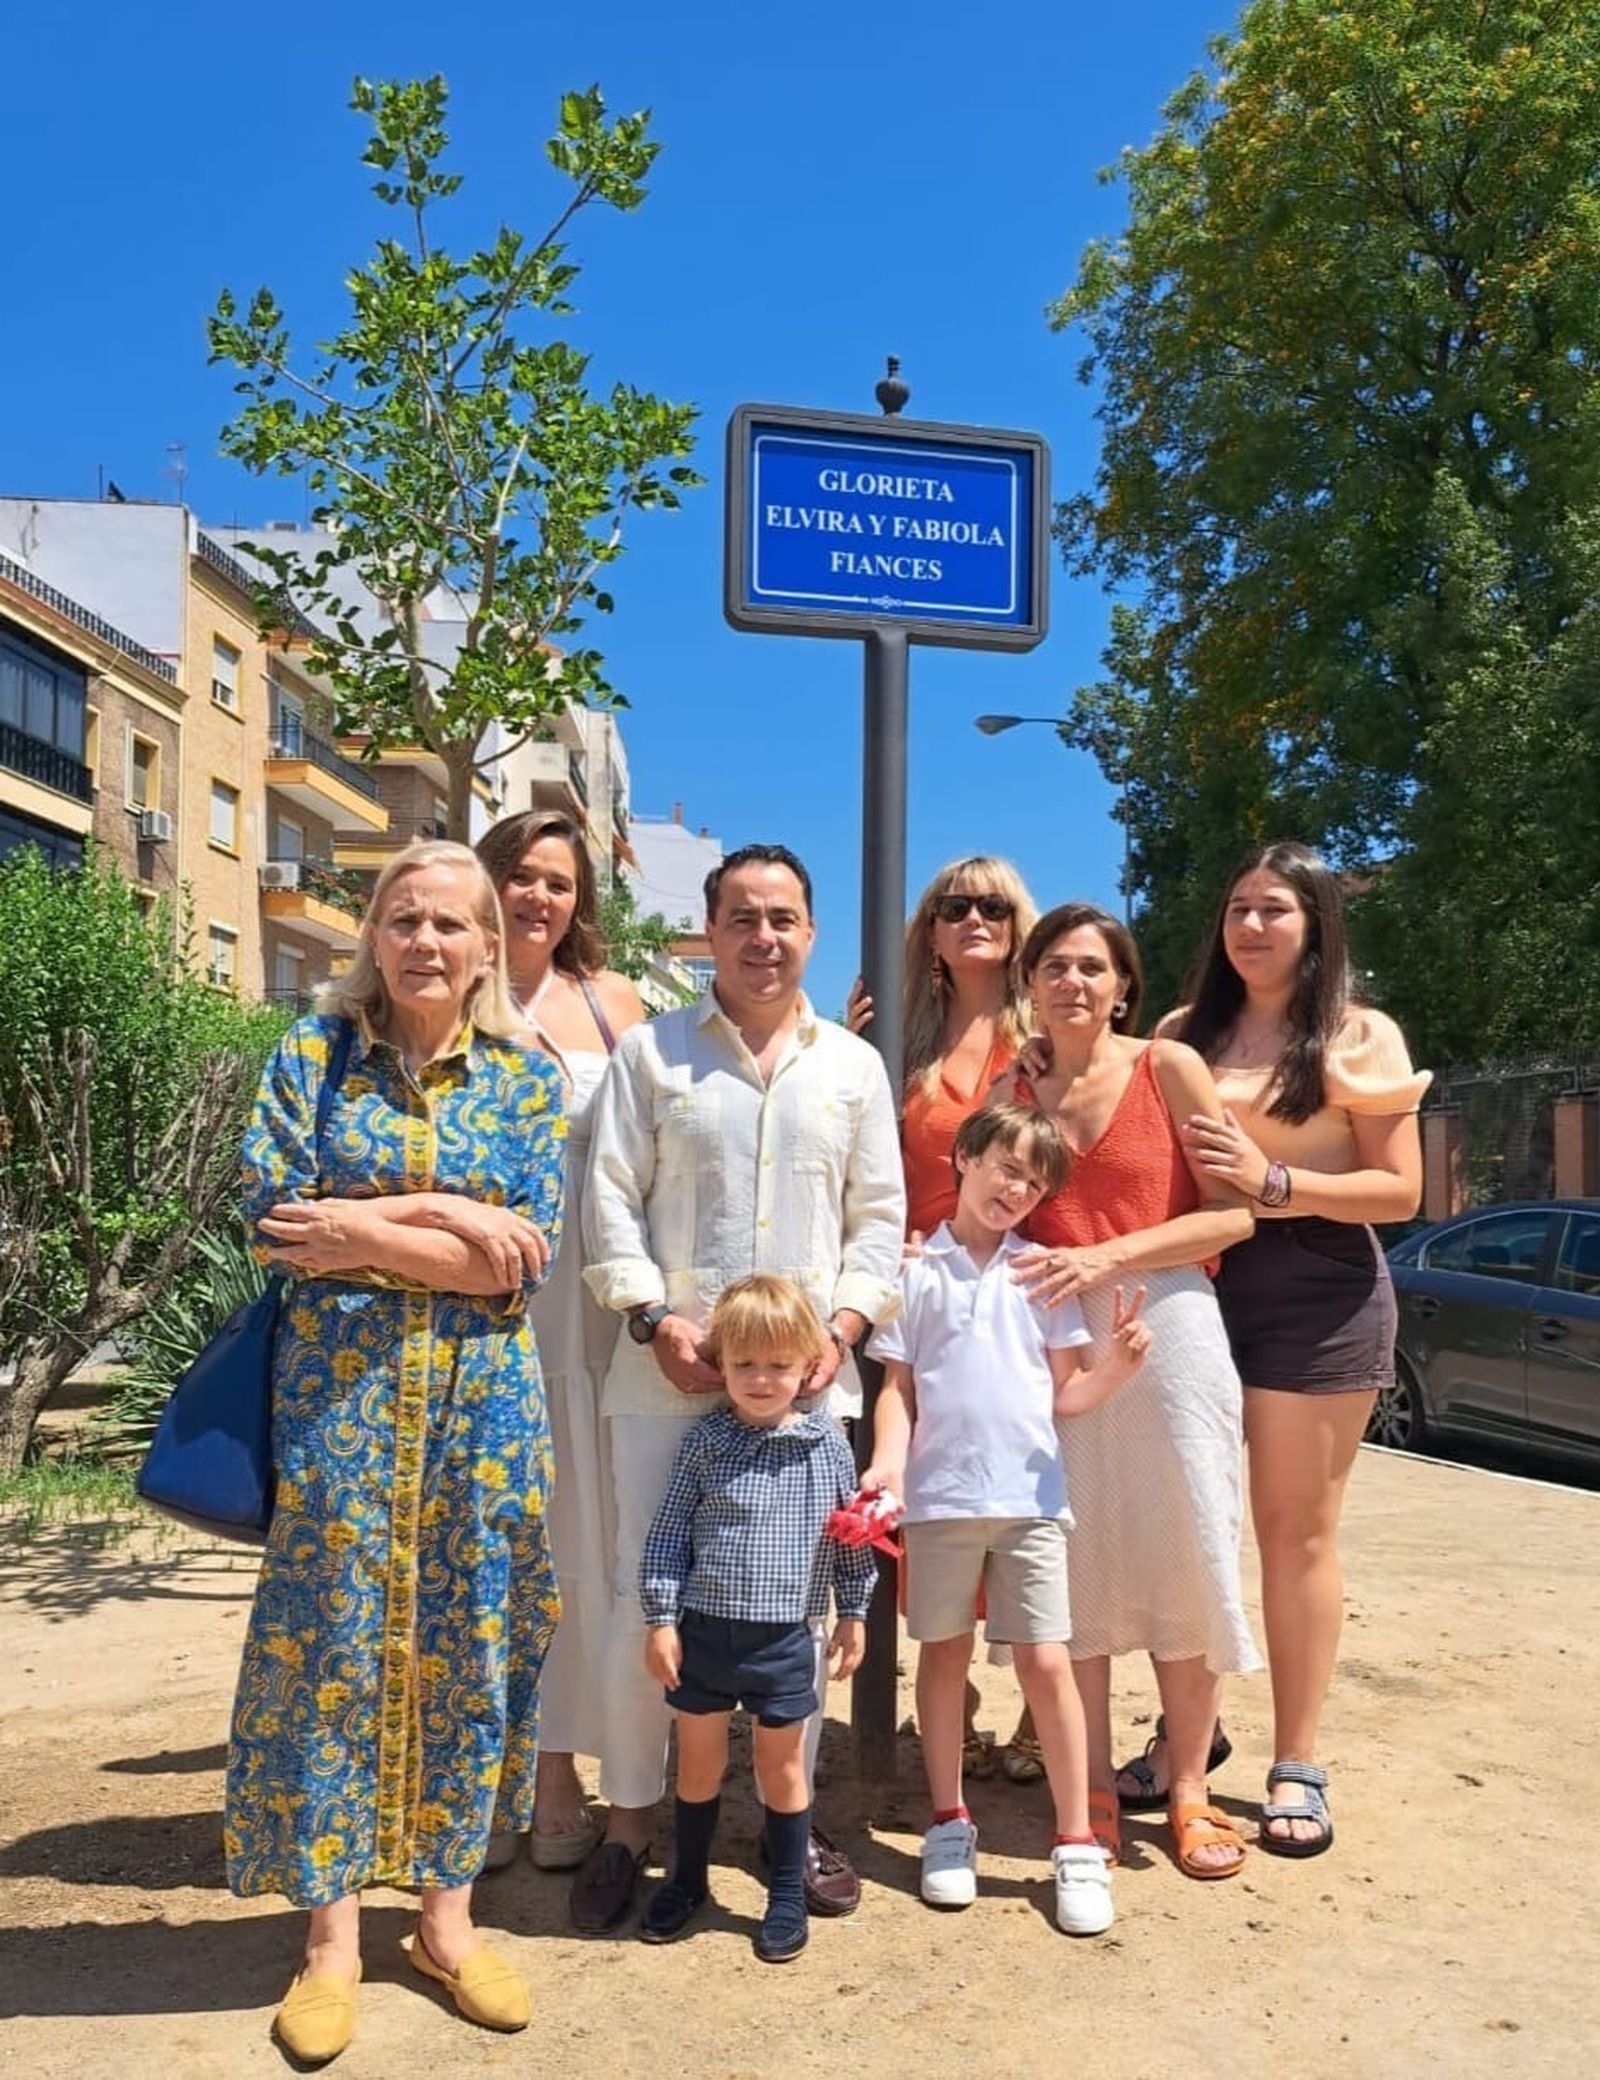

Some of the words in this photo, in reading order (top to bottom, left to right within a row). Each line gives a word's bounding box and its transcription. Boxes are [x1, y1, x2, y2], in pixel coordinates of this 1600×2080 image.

[818, 468, 955, 502] GLORIETA
[766, 504, 864, 534] ELVIRA
[868, 514, 887, 536] Y
[892, 516, 1005, 547] FABIOLA
[830, 551, 943, 581] FIANCES
